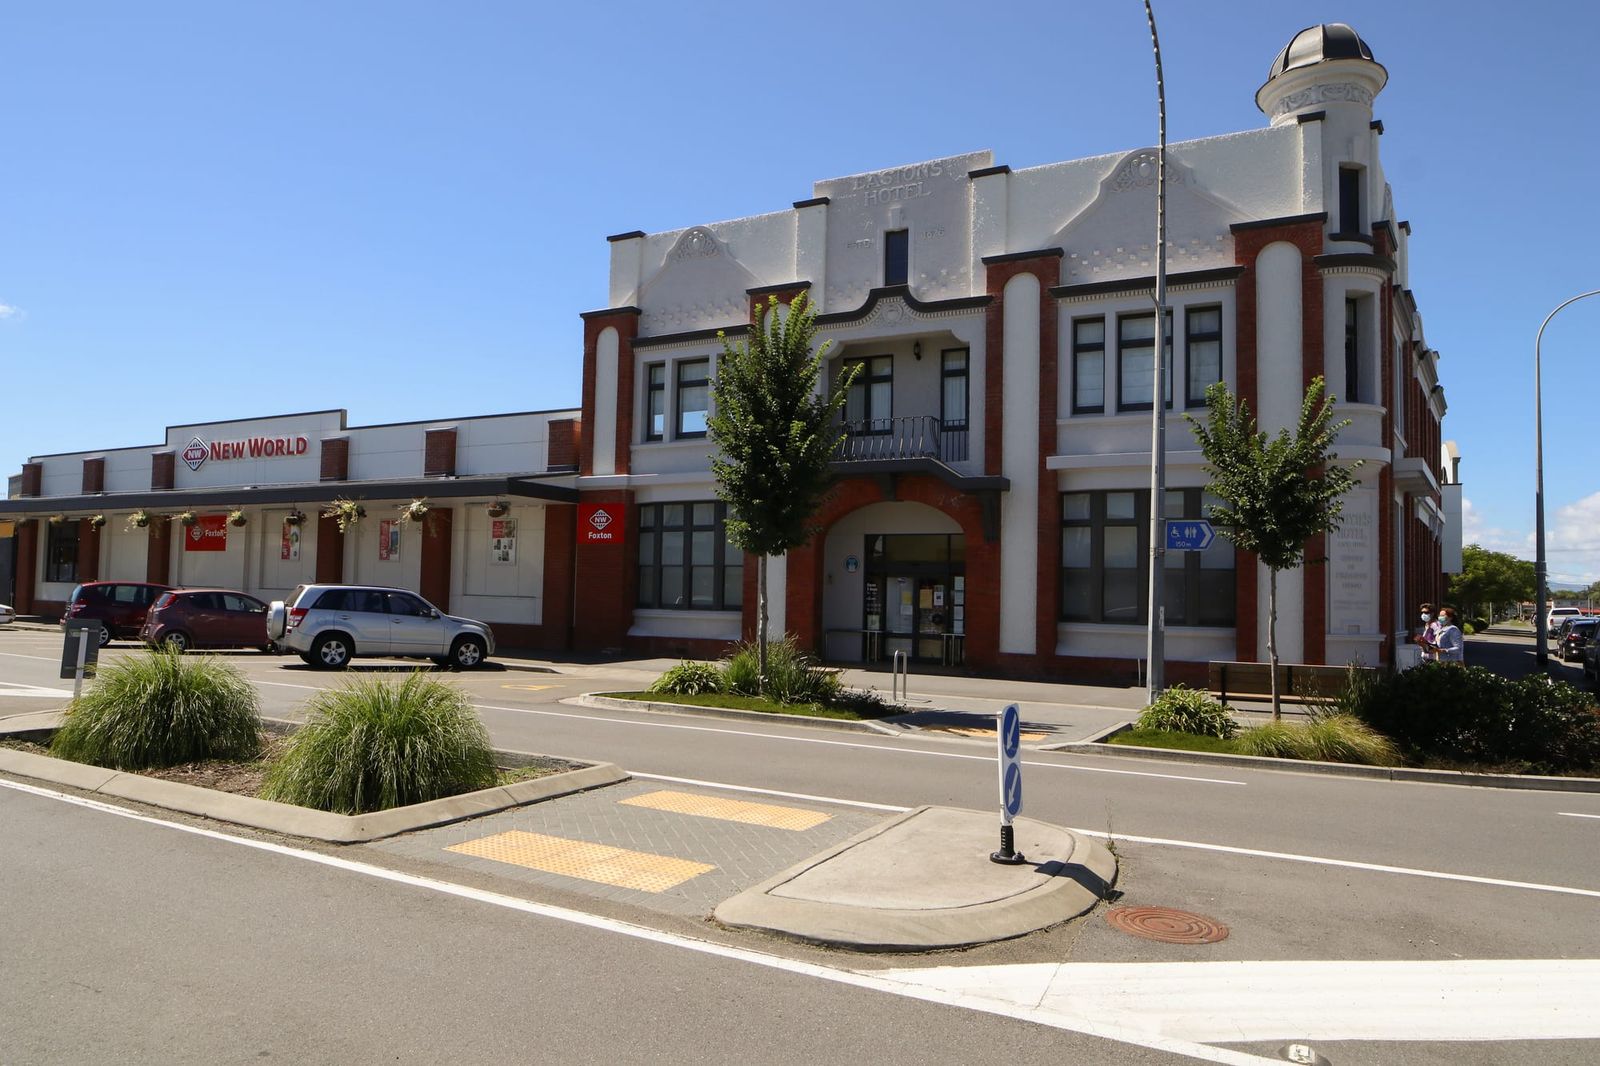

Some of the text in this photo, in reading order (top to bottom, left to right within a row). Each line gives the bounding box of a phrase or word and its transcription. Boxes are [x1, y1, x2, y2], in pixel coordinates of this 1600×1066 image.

[864, 182, 932, 206] HOTEL
[188, 449, 202, 458] NW
[211, 437, 308, 461] NEW WORLD
[204, 529, 224, 538] Foxton
[588, 531, 612, 539] Foxton
